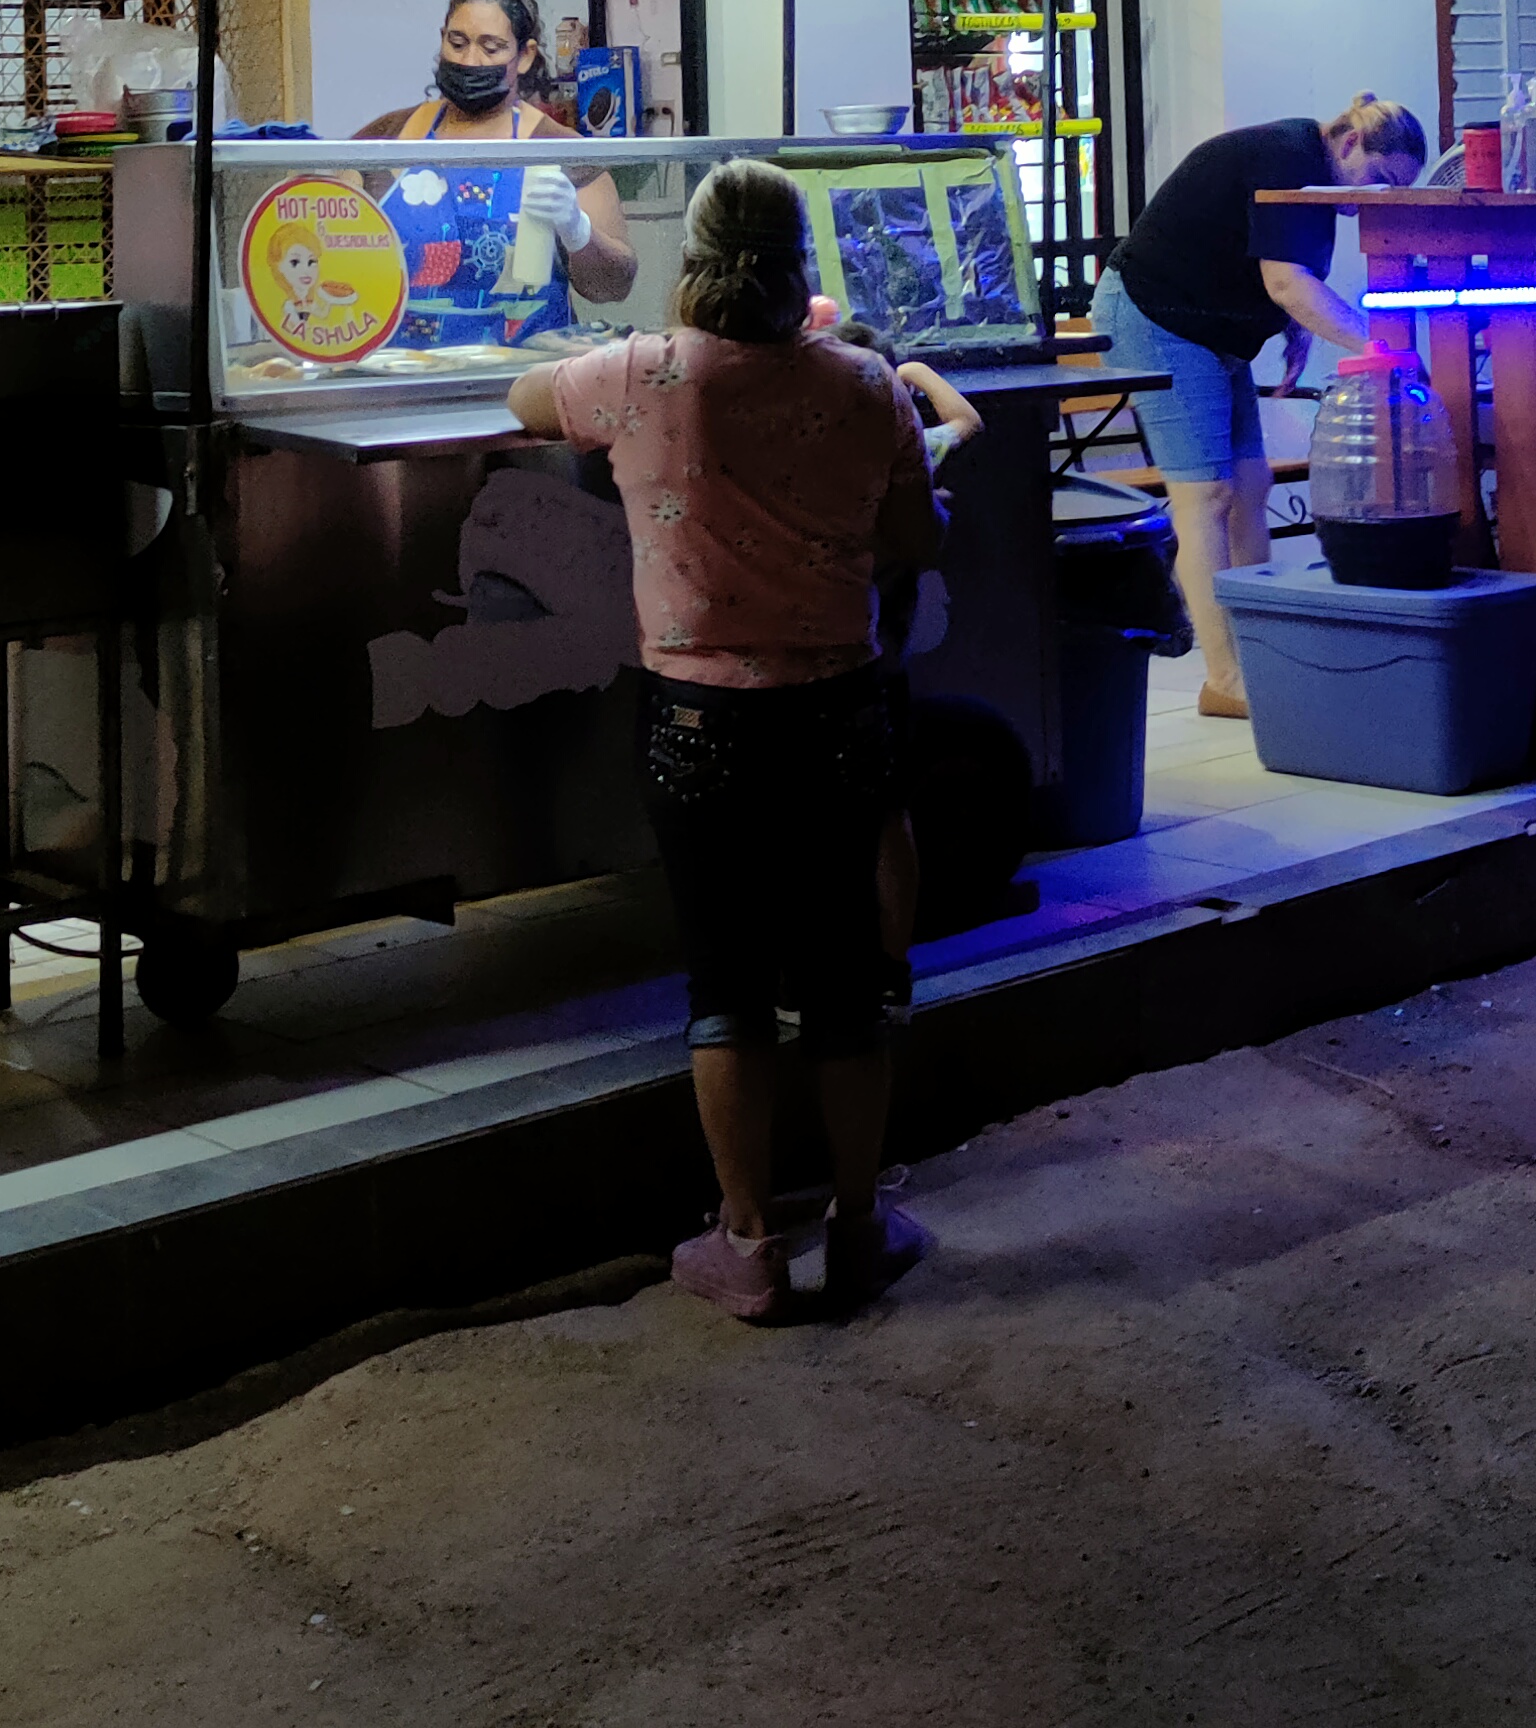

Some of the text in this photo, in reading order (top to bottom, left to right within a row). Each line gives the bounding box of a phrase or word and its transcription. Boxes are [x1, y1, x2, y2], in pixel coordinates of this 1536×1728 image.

[277, 197, 359, 220] HOT-DOGS
[324, 233, 391, 249] QUESADILLAS
[281, 311, 378, 346] LA SHULA
